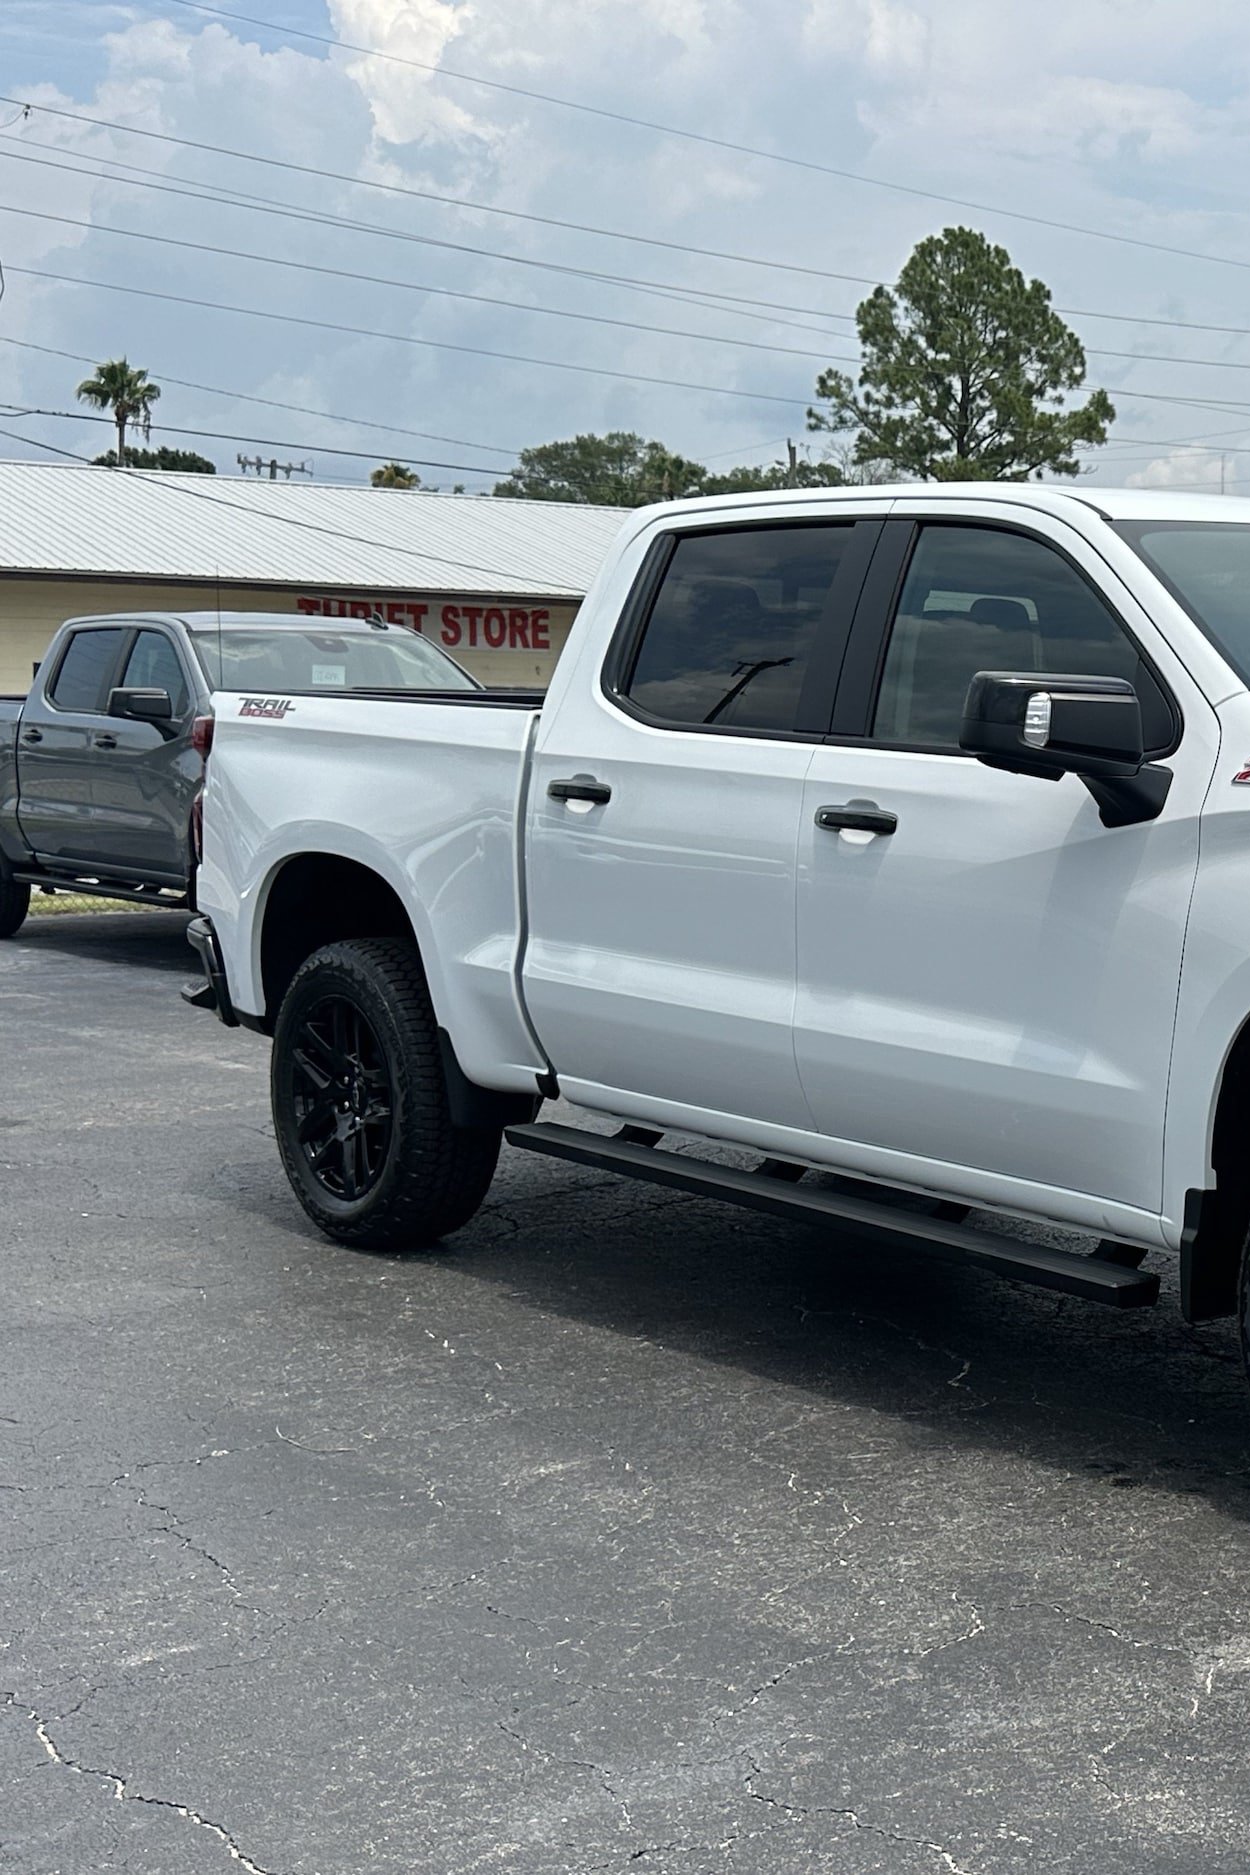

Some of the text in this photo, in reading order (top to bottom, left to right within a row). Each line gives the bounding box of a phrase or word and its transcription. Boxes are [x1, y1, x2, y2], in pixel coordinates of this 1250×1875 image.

[441, 604, 550, 649] STORE
[238, 697, 296, 712] TRAIL
[238, 707, 286, 719] BOSS
